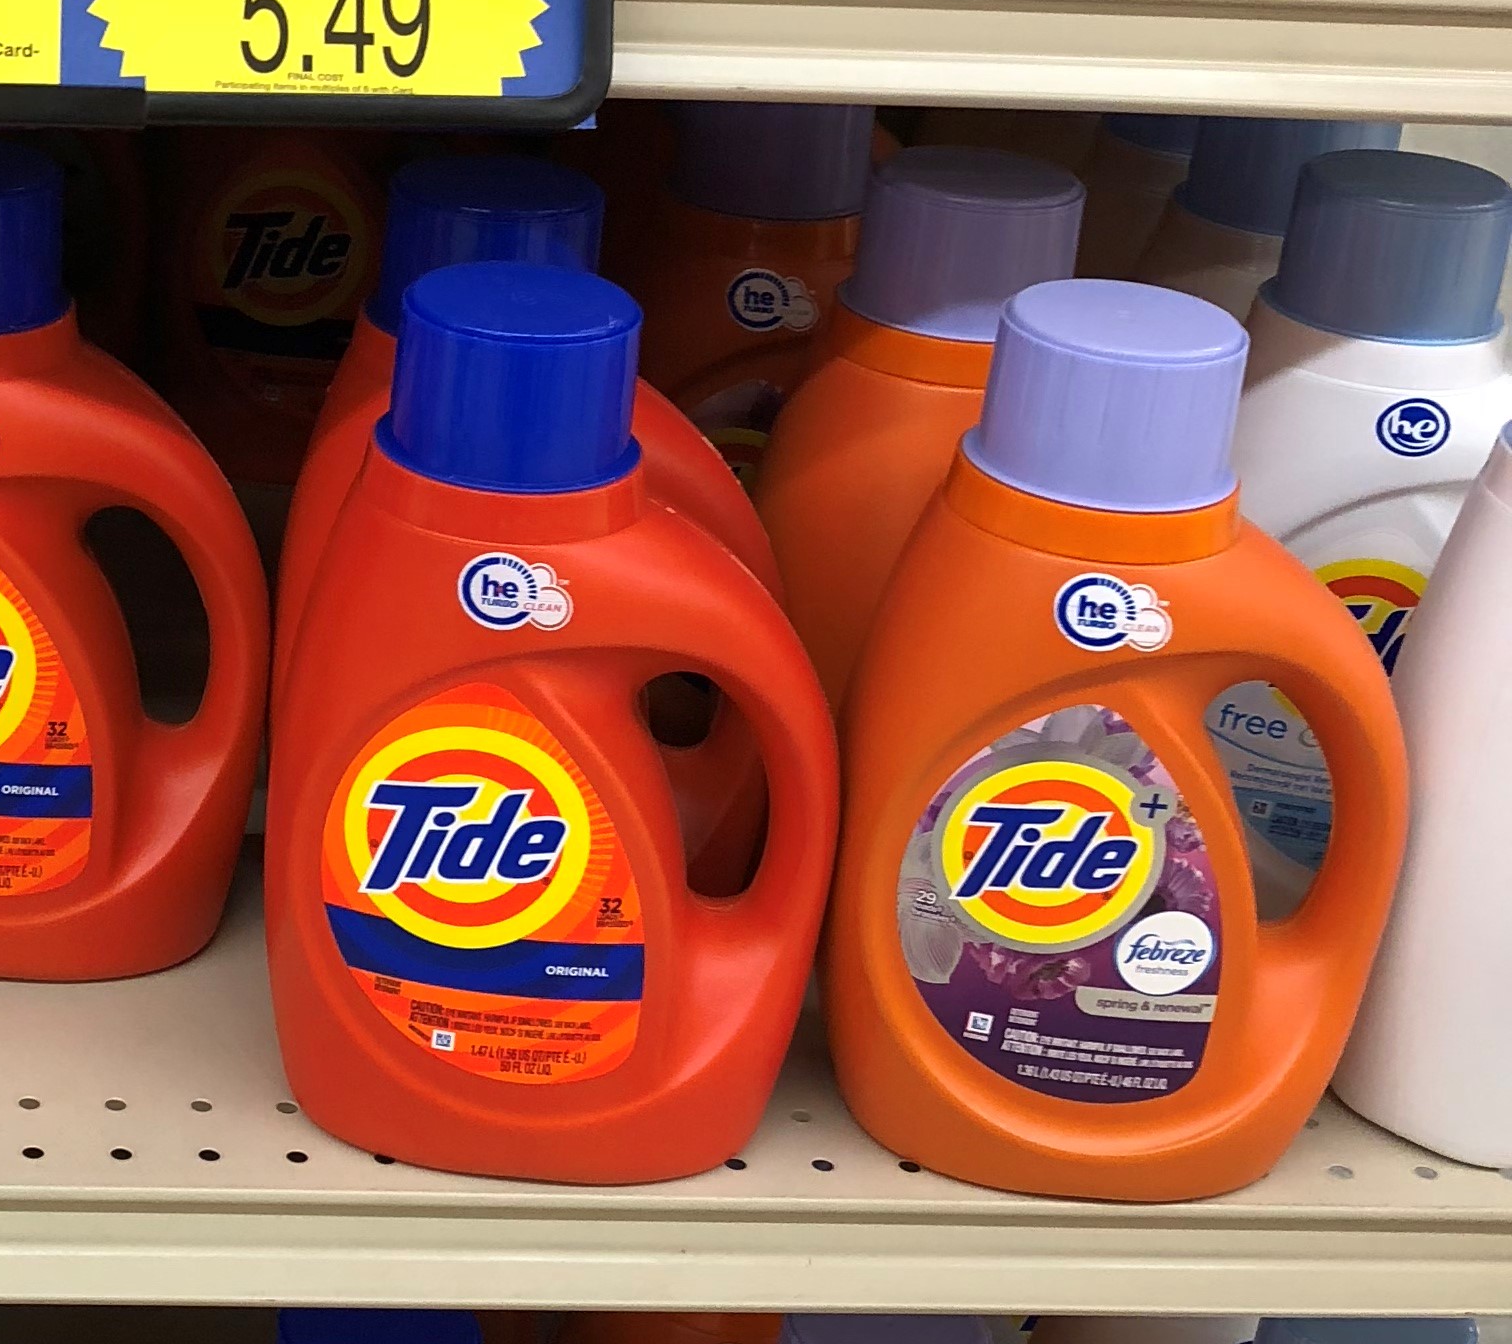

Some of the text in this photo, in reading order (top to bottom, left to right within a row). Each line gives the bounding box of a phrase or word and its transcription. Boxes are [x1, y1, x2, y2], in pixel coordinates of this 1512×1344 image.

[317, 73, 344, 82] COST
[223, 210, 352, 290] Tide
[743, 286, 775, 306] he
[1388, 404, 1439, 437] he
[482, 572, 519, 599] he
[523, 601, 562, 613] CLEAN
[1077, 594, 1117, 619] he
[46, 721, 67, 737] 32
[1219, 704, 1288, 739] free
[1, 784, 59, 797] ORIGINAL
[358, 779, 569, 894] Tide
[949, 805, 1138, 900] Tide
[599, 897, 622, 914] 32
[915, 890, 936, 904] 29
[1124, 931, 1207, 966] febreze
[545, 964, 609, 978] ORIGINAL
[1096, 998, 1138, 1013] spring
